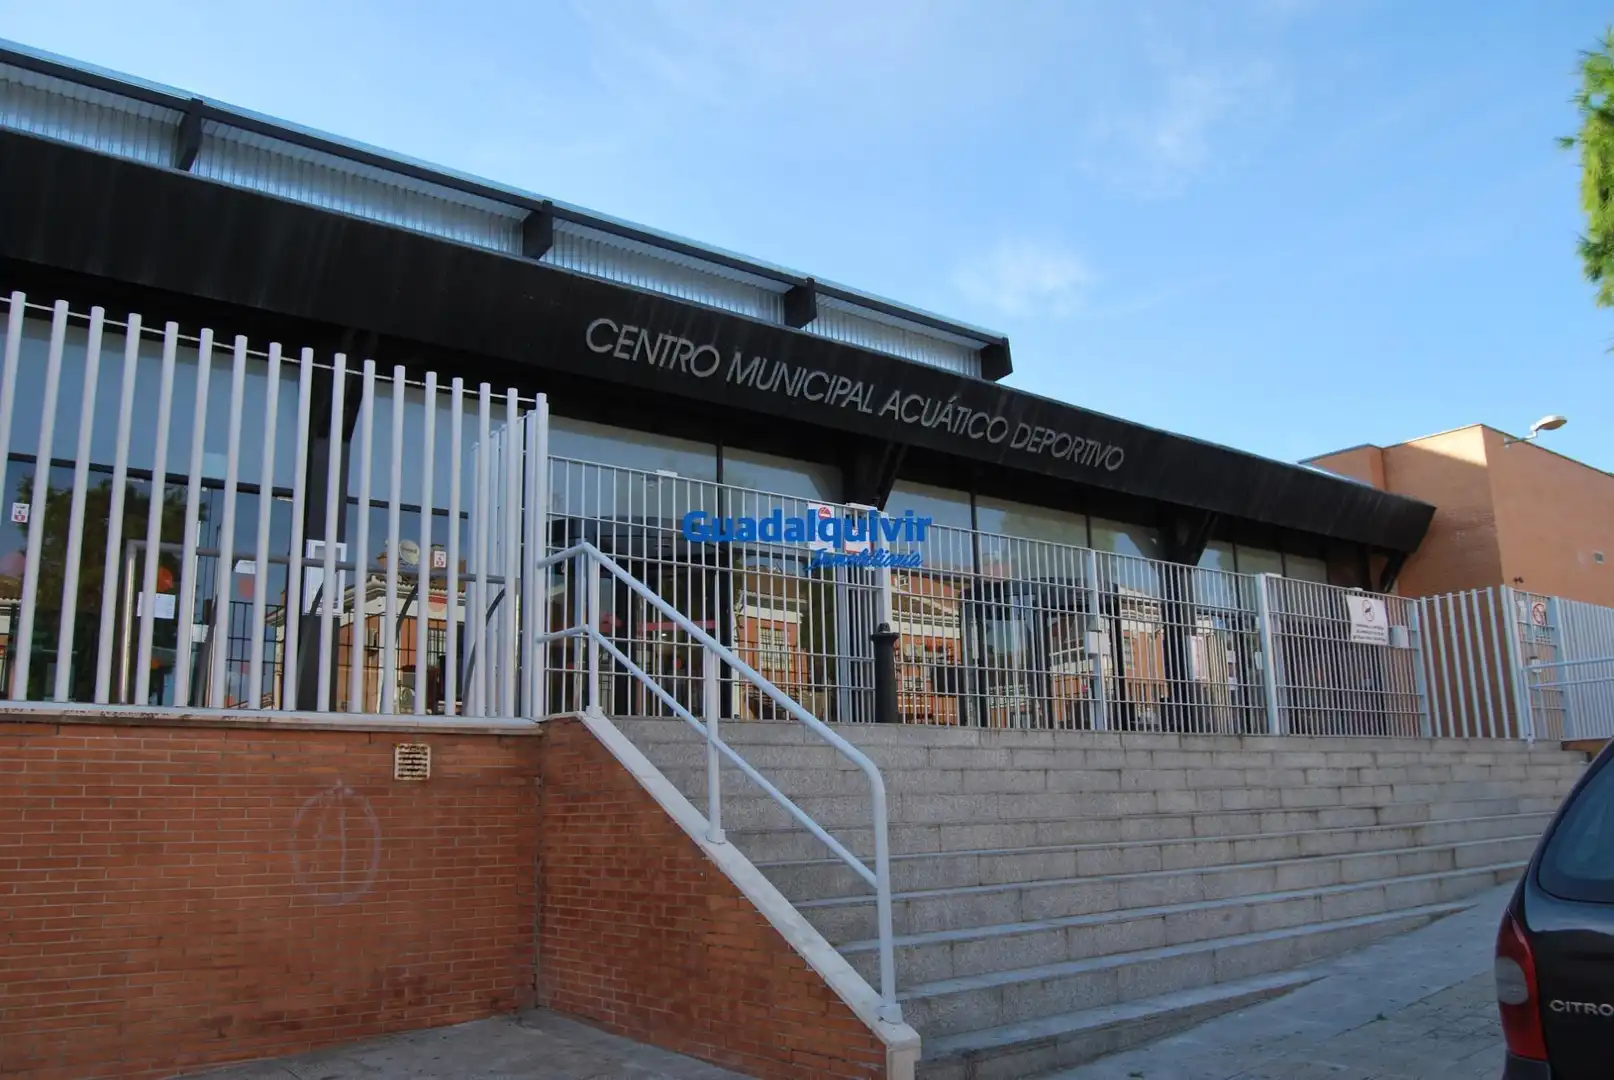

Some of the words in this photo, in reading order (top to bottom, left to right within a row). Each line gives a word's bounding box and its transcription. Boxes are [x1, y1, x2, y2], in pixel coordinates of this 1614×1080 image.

[585, 318, 720, 377] CENTRO
[726, 351, 873, 414] MUNICIPAL
[879, 390, 1009, 444] ACUÁTICO
[1010, 422, 1125, 471] DEPORTIVO
[1550, 1000, 1614, 1016] CITRO
